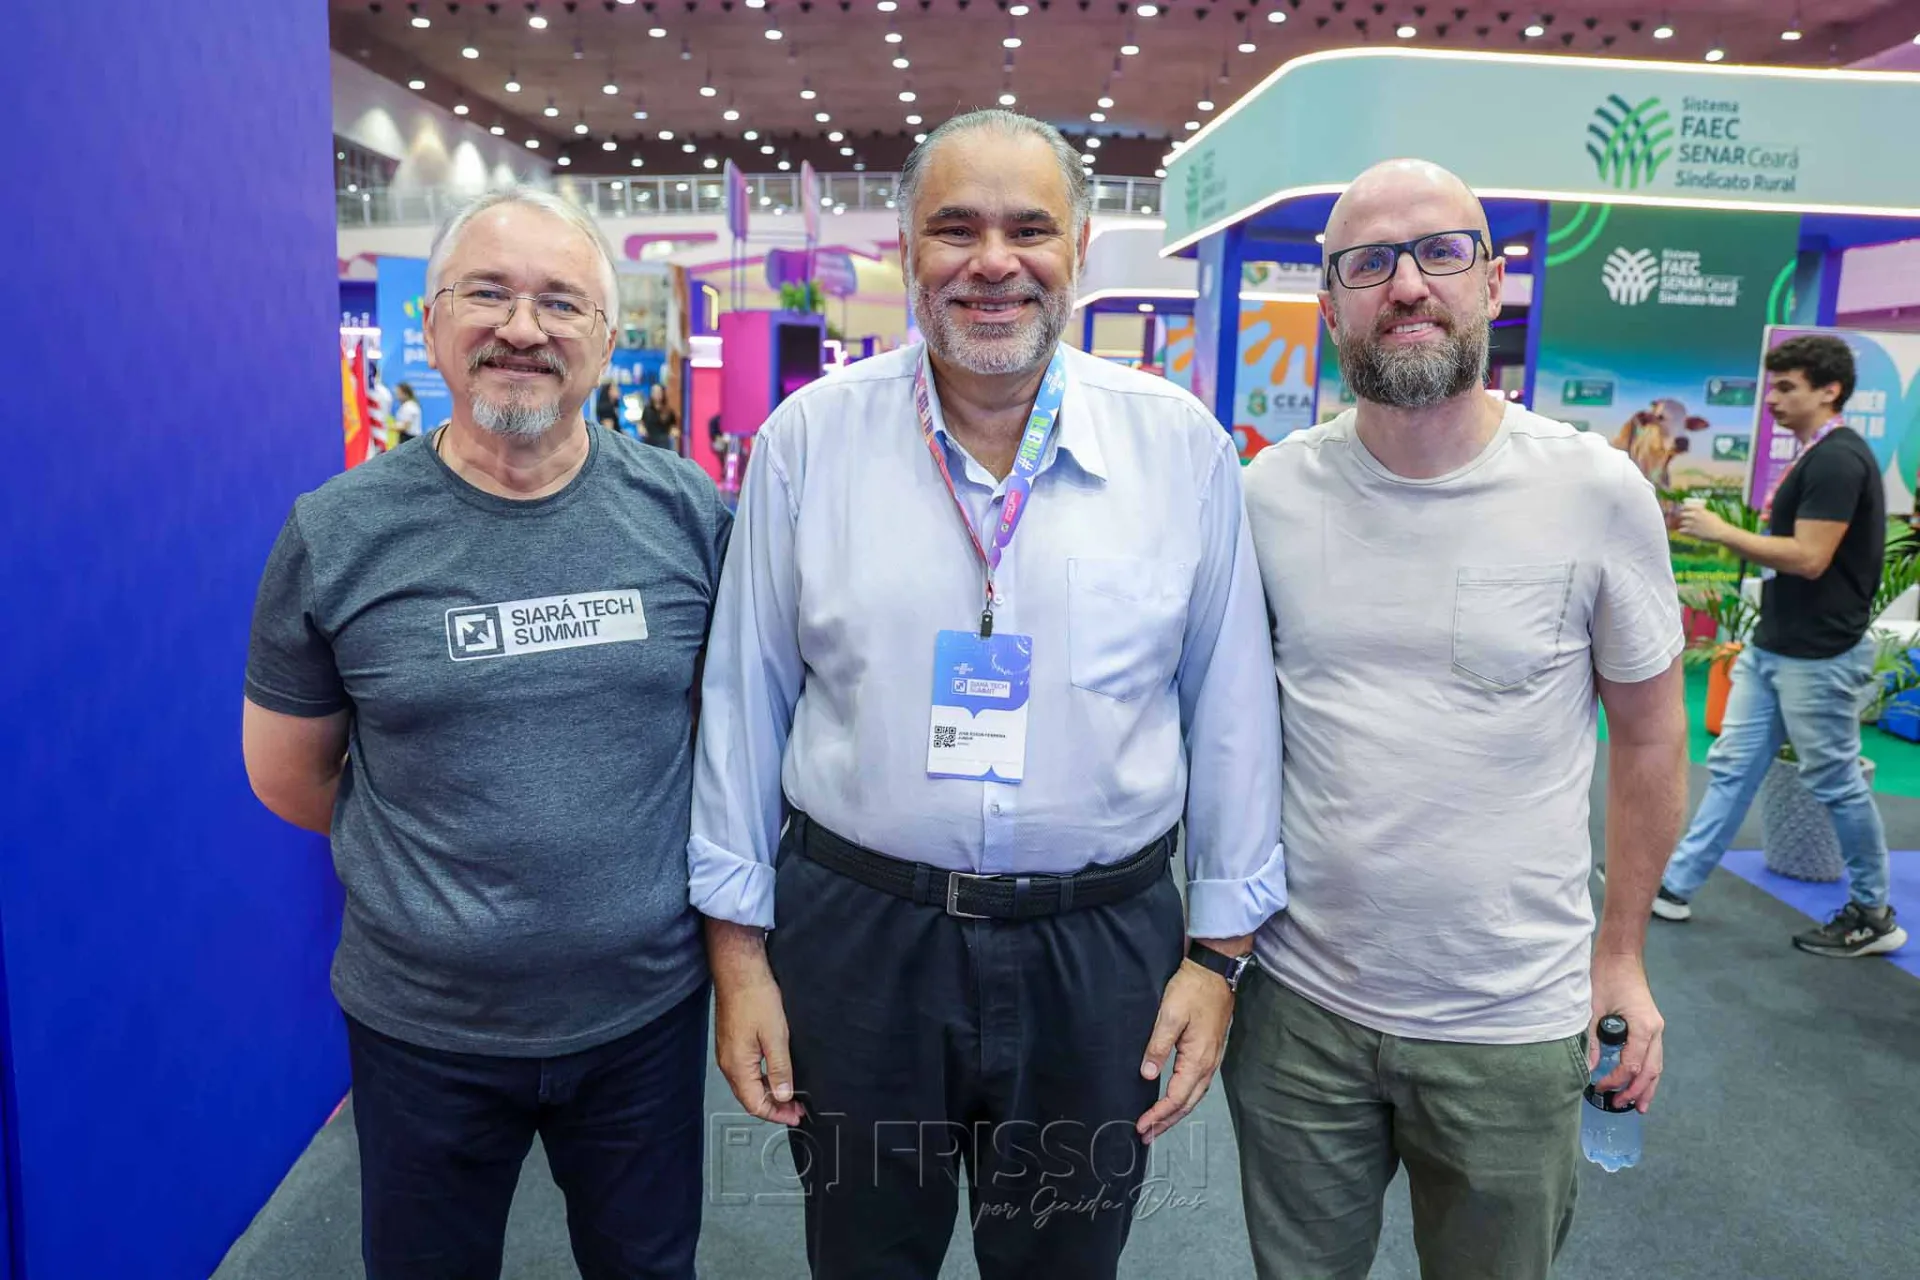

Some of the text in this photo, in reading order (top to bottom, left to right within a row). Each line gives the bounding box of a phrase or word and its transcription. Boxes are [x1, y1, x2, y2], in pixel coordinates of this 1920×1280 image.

[1682, 97, 1739, 112] Sistema
[1681, 115, 1740, 140] FAEC
[1678, 142, 1799, 170] SENAR Ceará
[1675, 169, 1796, 192] Sindicato Rural
[1662, 259, 1701, 276] FAEC
[511, 597, 634, 627] SIARÁ TECH
[514, 619, 601, 645] SUMMIT
